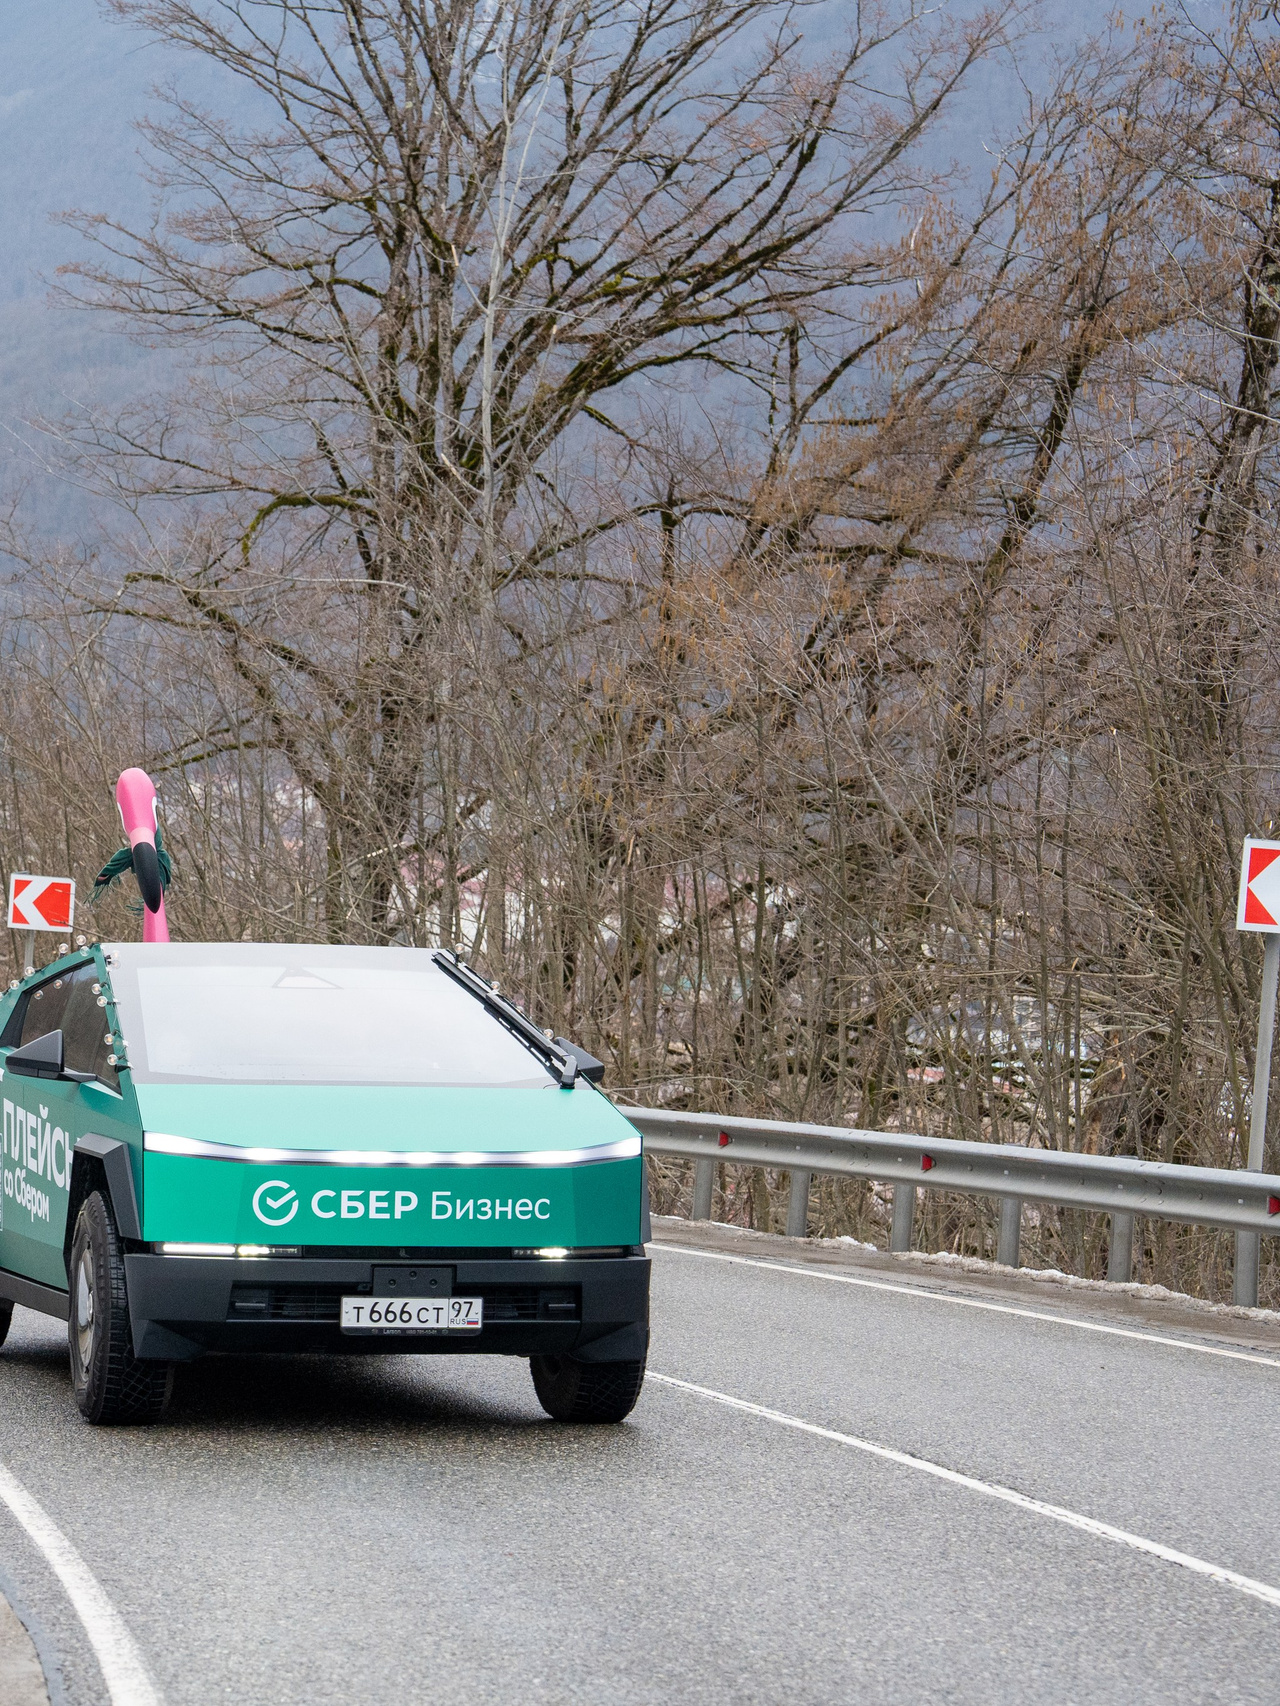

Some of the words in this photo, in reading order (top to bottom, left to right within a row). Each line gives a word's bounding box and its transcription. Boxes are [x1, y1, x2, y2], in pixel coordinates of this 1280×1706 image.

[4, 1168, 14, 1198] со
[14, 1167, 50, 1222] Сбером
[311, 1189, 419, 1220] СБЕР
[431, 1191, 551, 1221] Бизнес
[451, 1301, 474, 1318] 97
